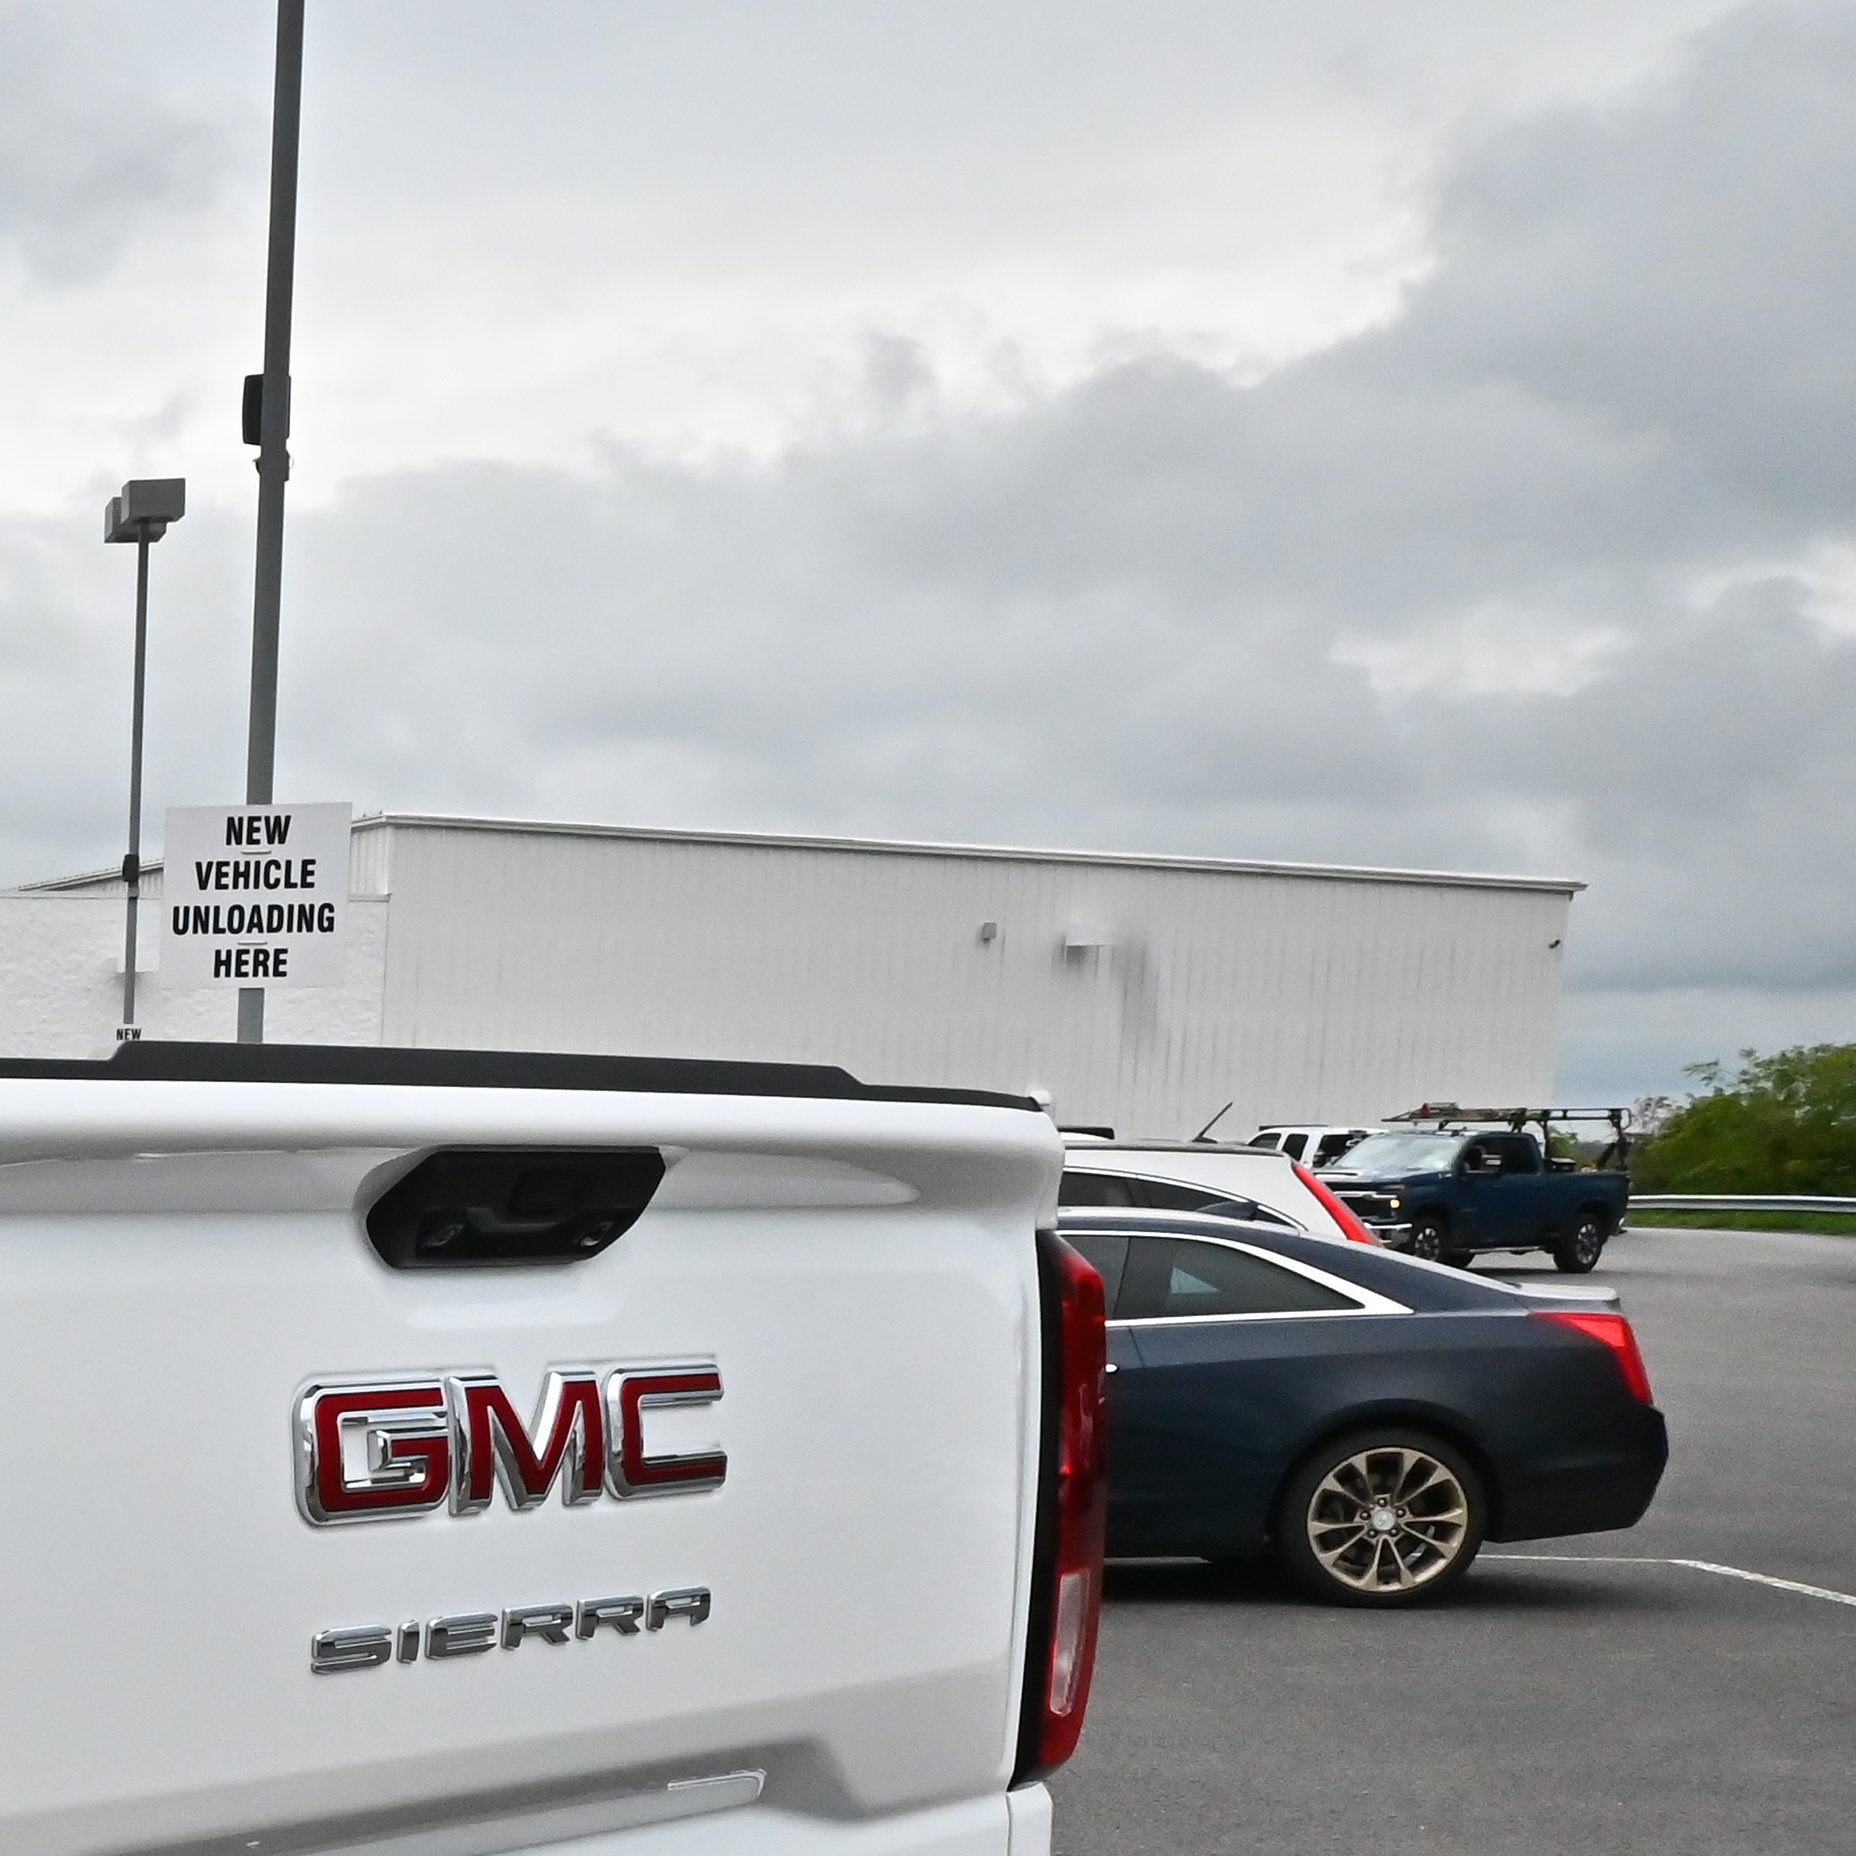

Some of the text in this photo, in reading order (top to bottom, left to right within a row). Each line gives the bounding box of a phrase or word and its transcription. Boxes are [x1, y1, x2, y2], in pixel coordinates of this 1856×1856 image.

[225, 815, 292, 846] NEW
[195, 858, 316, 890] VEHICLE
[172, 902, 336, 935] UNLOADING
[213, 948, 289, 978] HERE
[116, 1027, 142, 1041] NEW
[291, 1354, 728, 1528] GMC
[310, 1585, 712, 1676] SIERRA
